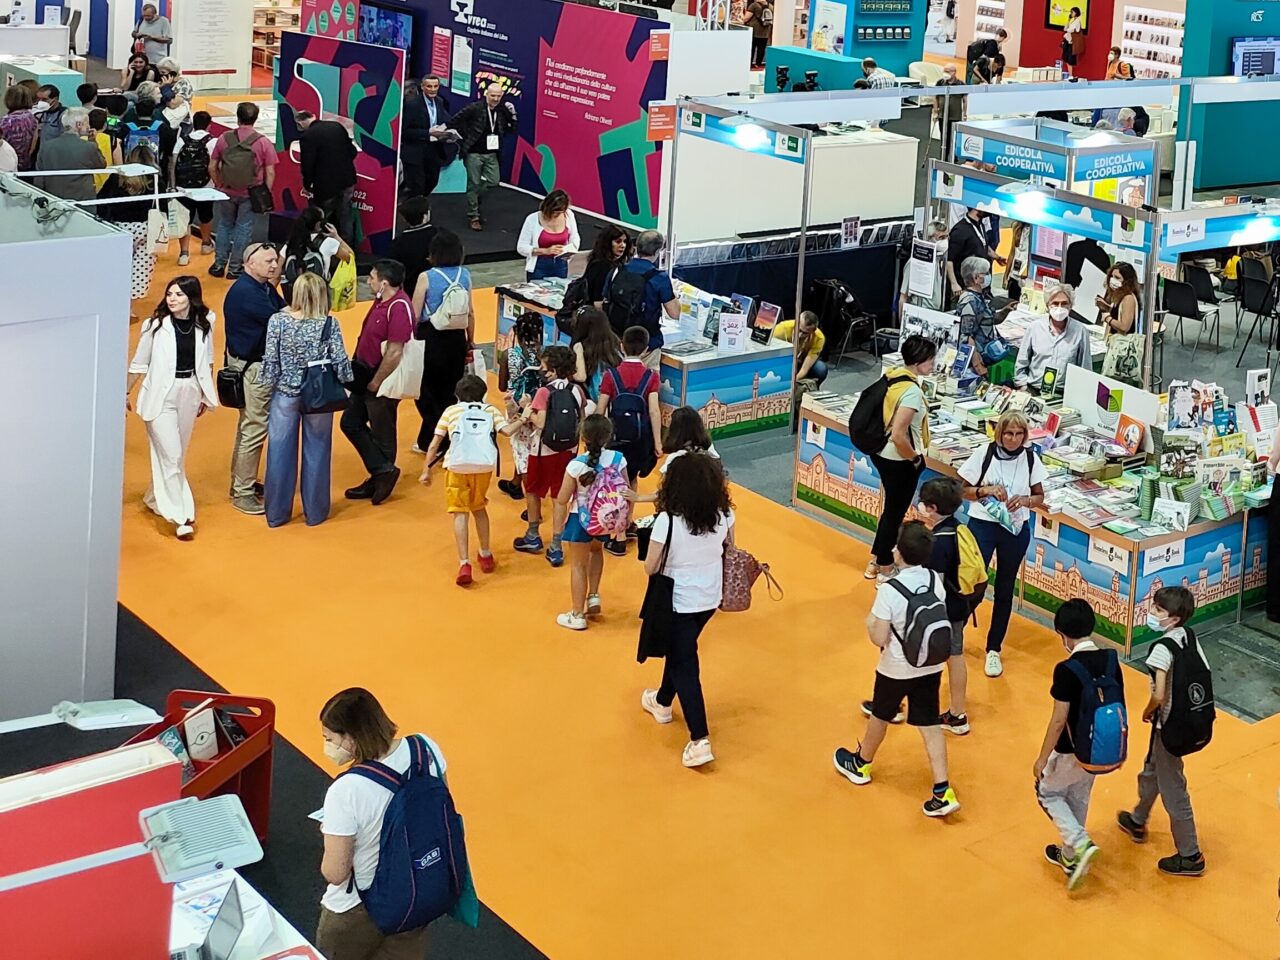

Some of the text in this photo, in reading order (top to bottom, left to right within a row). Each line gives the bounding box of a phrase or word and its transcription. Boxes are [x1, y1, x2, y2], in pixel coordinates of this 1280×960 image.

[1005, 145, 1043, 159] EDICOLA
[996, 156, 1055, 174] COOPERATIVA
[1094, 154, 1132, 169] EDICOLA
[1086, 161, 1146, 180] COOPERATIVA
[353, 191, 367, 200] 022
[358, 202, 374, 212] Libro
[1093, 545, 1123, 561] Homeless Book
[1149, 547, 1180, 562] Homeless Book
